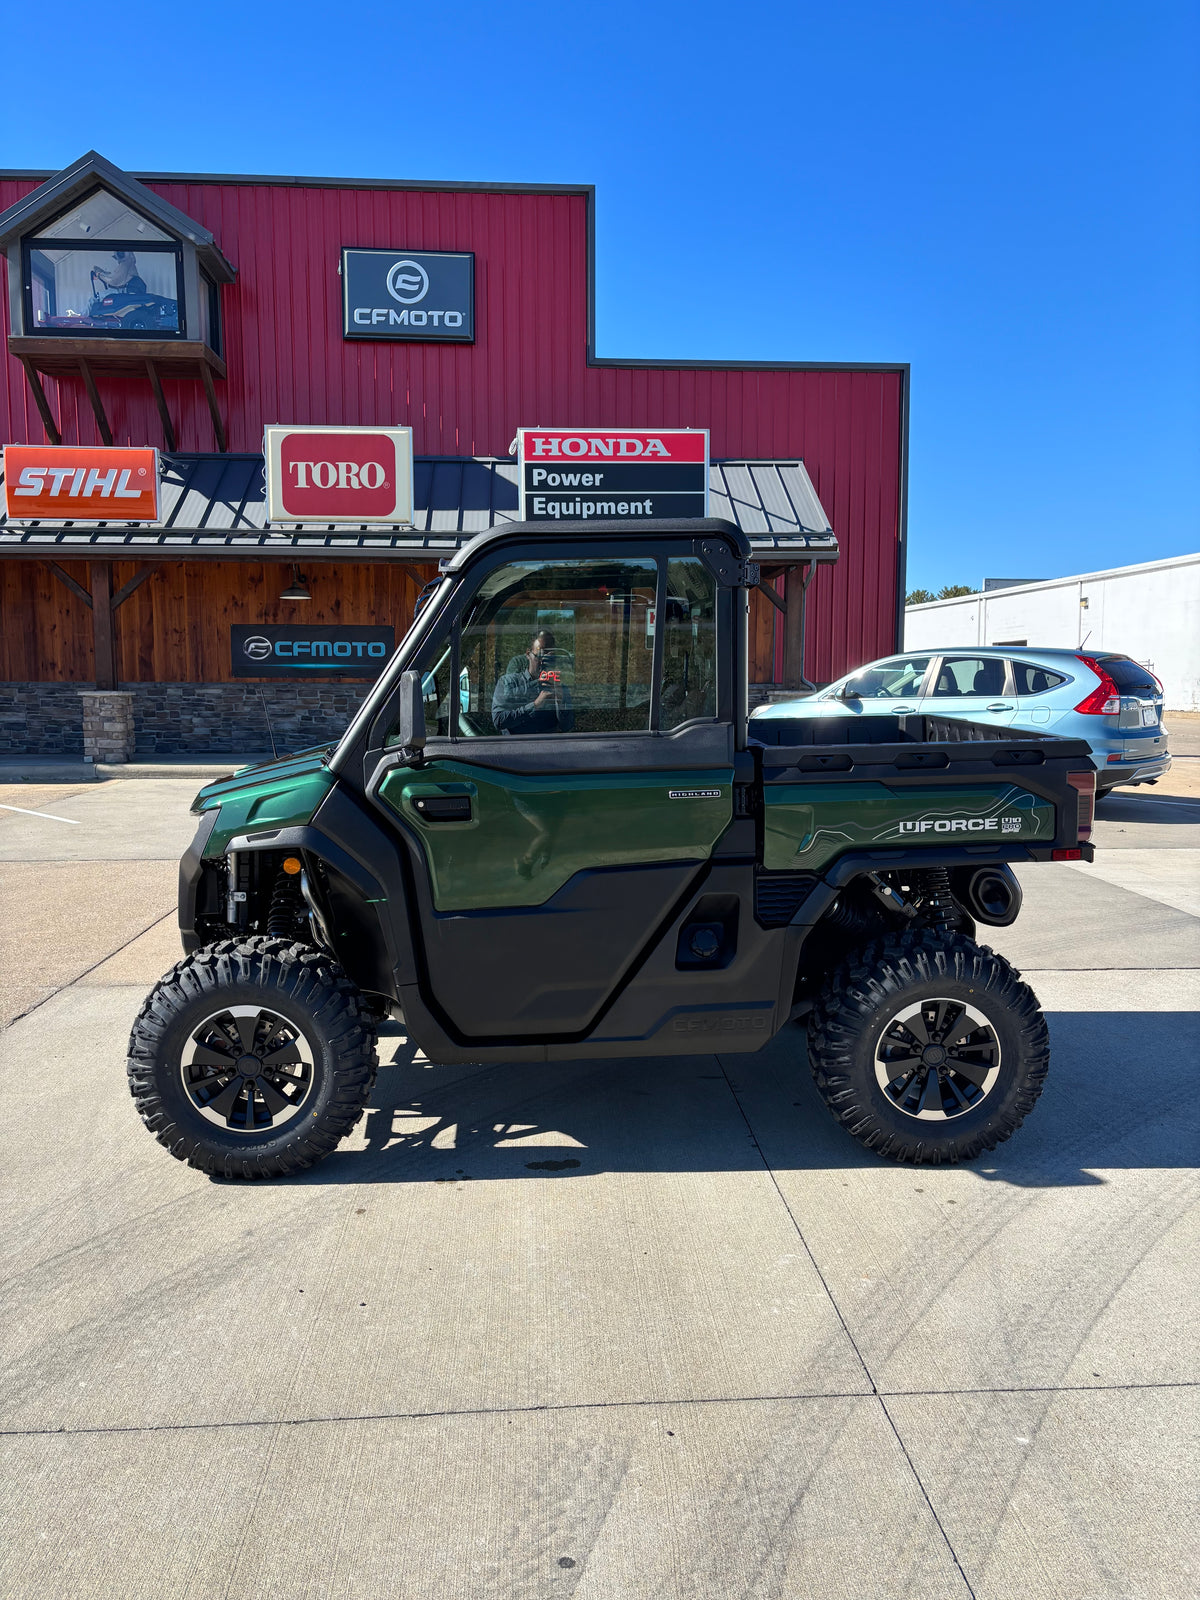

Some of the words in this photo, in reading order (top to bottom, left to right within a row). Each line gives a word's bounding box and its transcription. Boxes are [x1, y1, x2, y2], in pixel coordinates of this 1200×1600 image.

[353, 307, 463, 327] CFMOTO
[532, 437, 671, 457] HONDA
[13, 467, 142, 498] STIHL
[289, 461, 386, 489] TORO
[532, 468, 603, 486] Power
[533, 497, 653, 519] Equipment
[274, 641, 386, 657] CFMOTO
[899, 818, 999, 833] UFORCE
